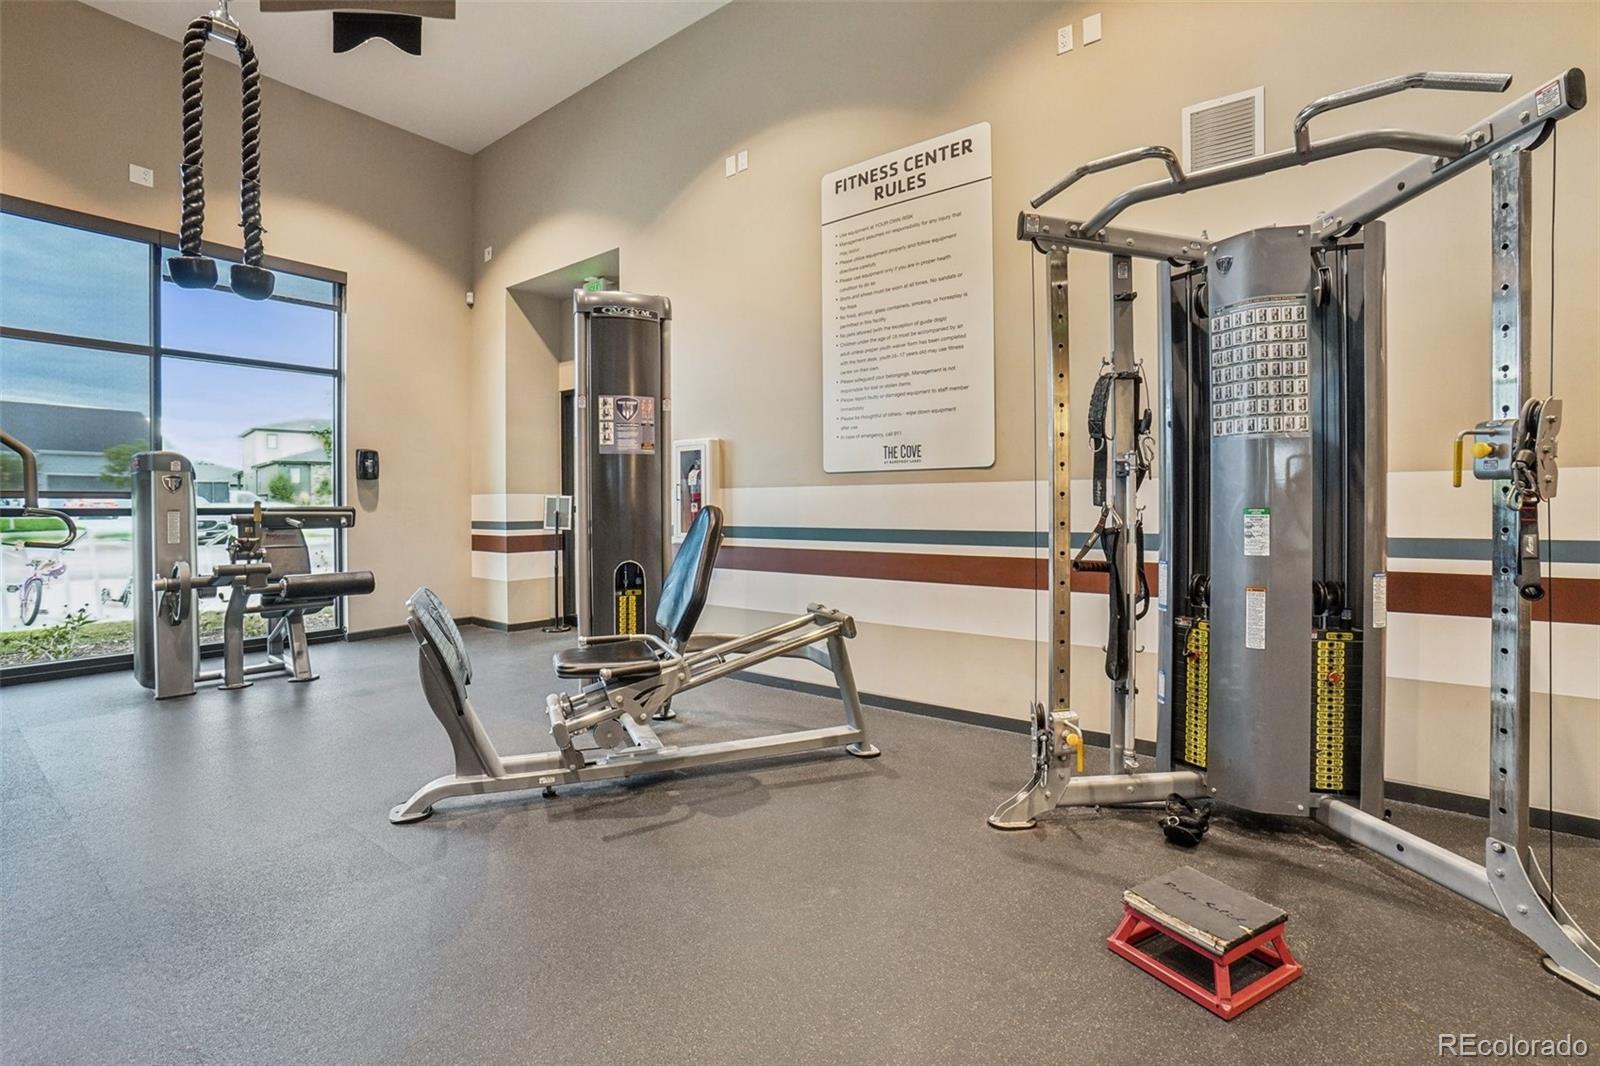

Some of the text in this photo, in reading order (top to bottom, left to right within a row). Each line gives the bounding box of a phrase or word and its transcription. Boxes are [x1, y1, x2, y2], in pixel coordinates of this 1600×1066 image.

[835, 138, 973, 194] FITNESS CENTER
[874, 172, 927, 201] RULES
[938, 213, 950, 222] injury
[866, 249, 888, 259] equipment
[888, 244, 906, 254] properly
[931, 232, 956, 244] equipment
[862, 269, 883, 279] equipment
[884, 444, 922, 459] THE COVE
